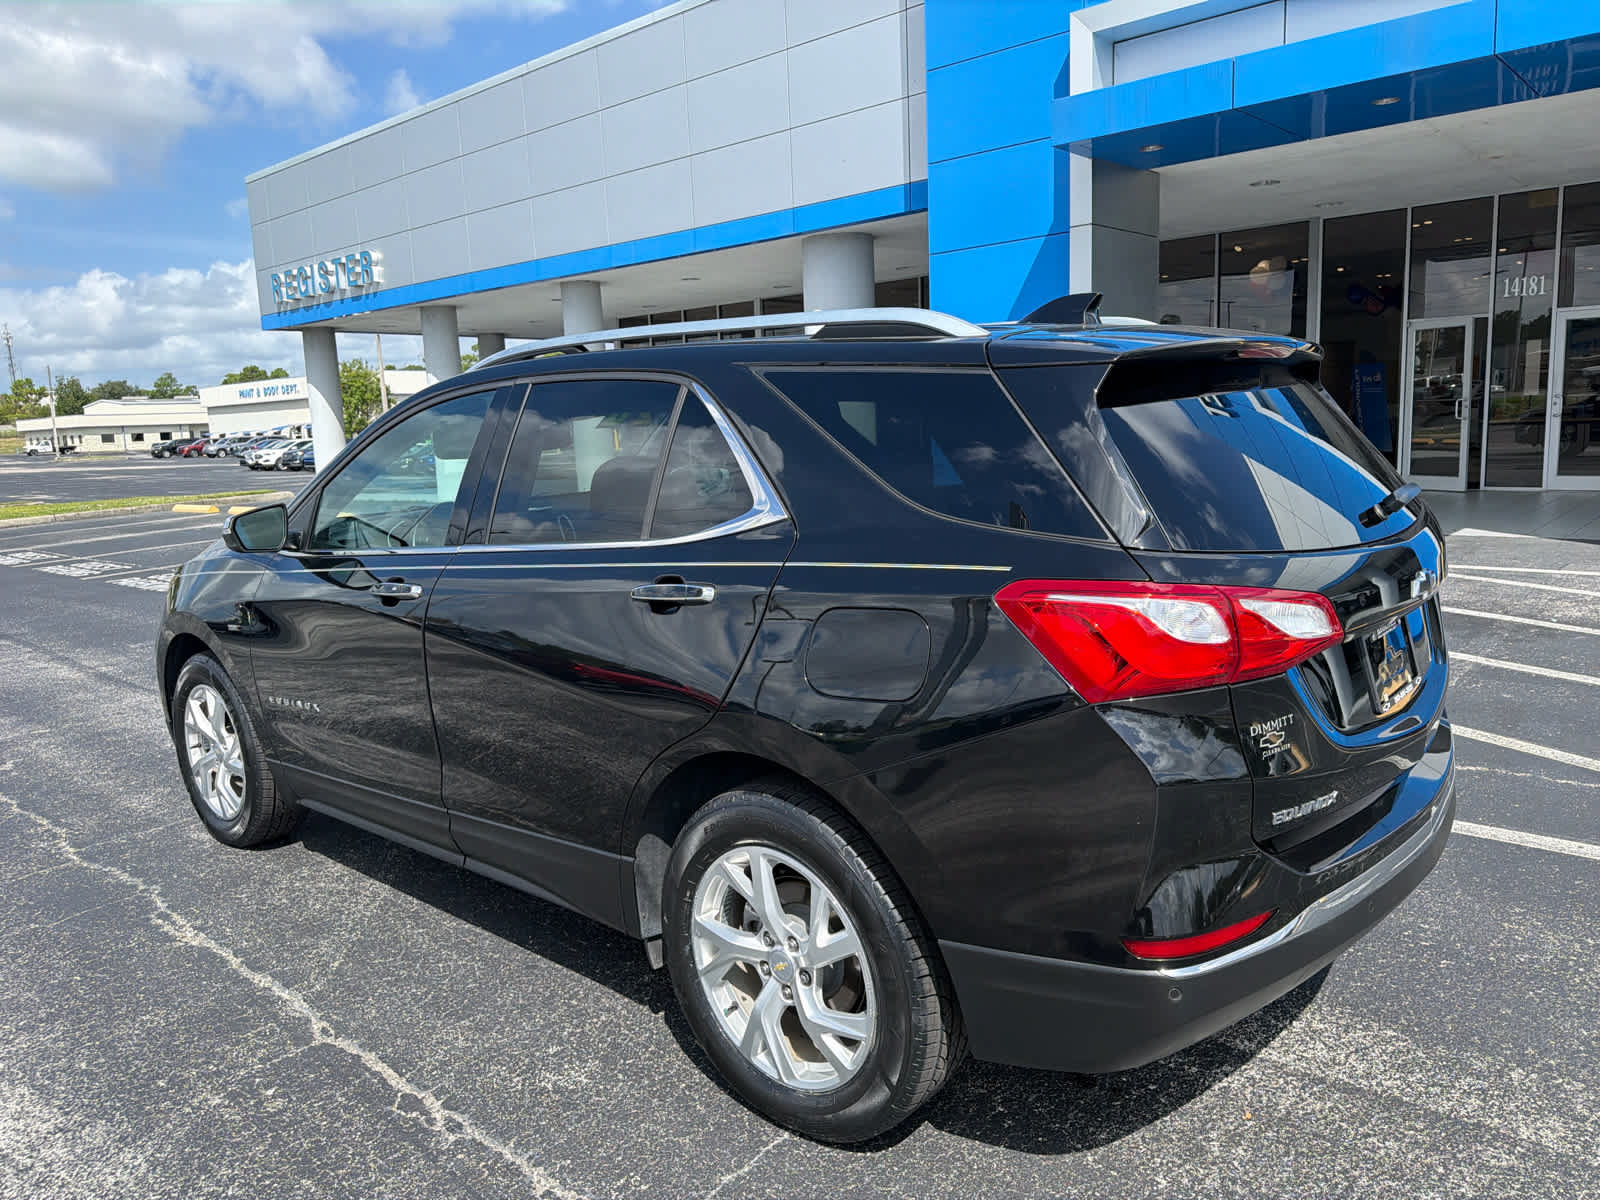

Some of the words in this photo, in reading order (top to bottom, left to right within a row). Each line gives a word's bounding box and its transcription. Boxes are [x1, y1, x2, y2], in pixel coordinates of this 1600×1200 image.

[271, 250, 376, 304] REGISTER
[1503, 275, 1547, 298] 14181
[263, 385, 278, 397] BODY
[1250, 713, 1294, 737] DIMMITT
[1271, 790, 1339, 825] EQUINOX
